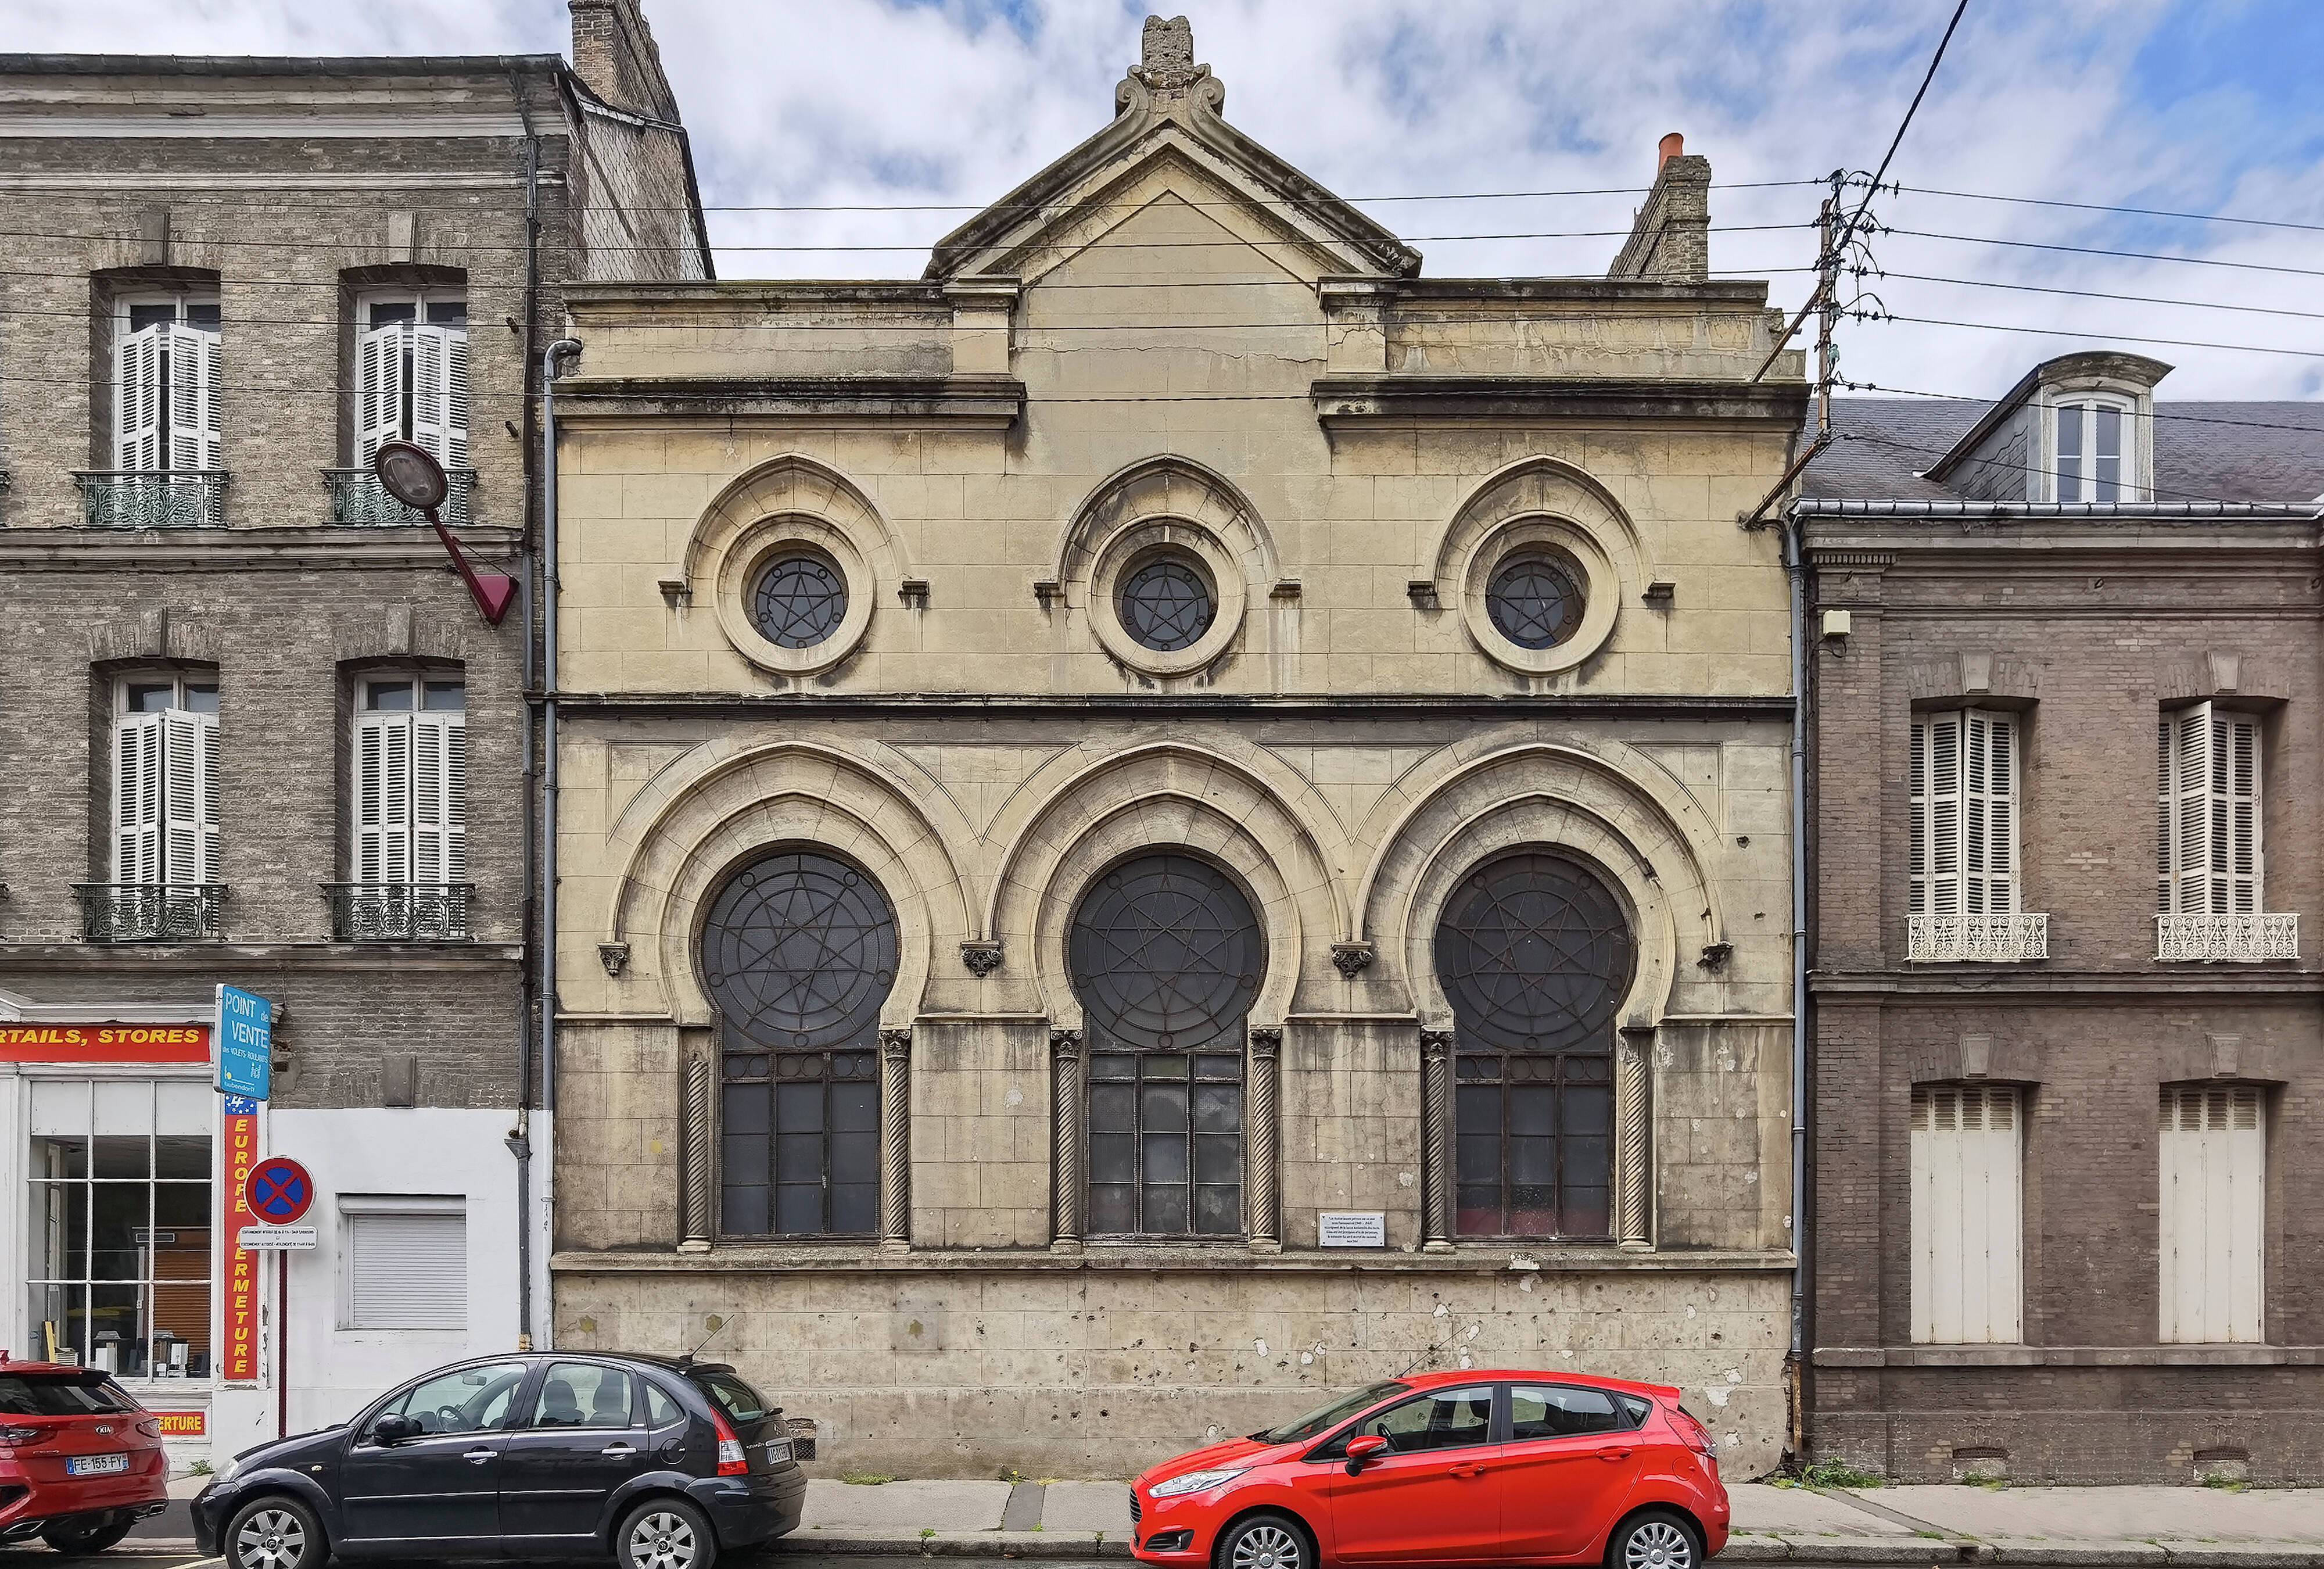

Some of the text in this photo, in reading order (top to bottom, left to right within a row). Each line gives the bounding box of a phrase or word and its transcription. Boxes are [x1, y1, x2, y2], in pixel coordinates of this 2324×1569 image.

[225, 992, 268, 1022] POINT de
[98, 1029, 199, 1044] STORES
[231, 1020, 269, 1049] VENTE
[234, 1119, 249, 1373] EUROPE ERMETURE
[74, 1456, 121, 1471] FE-155-FY
